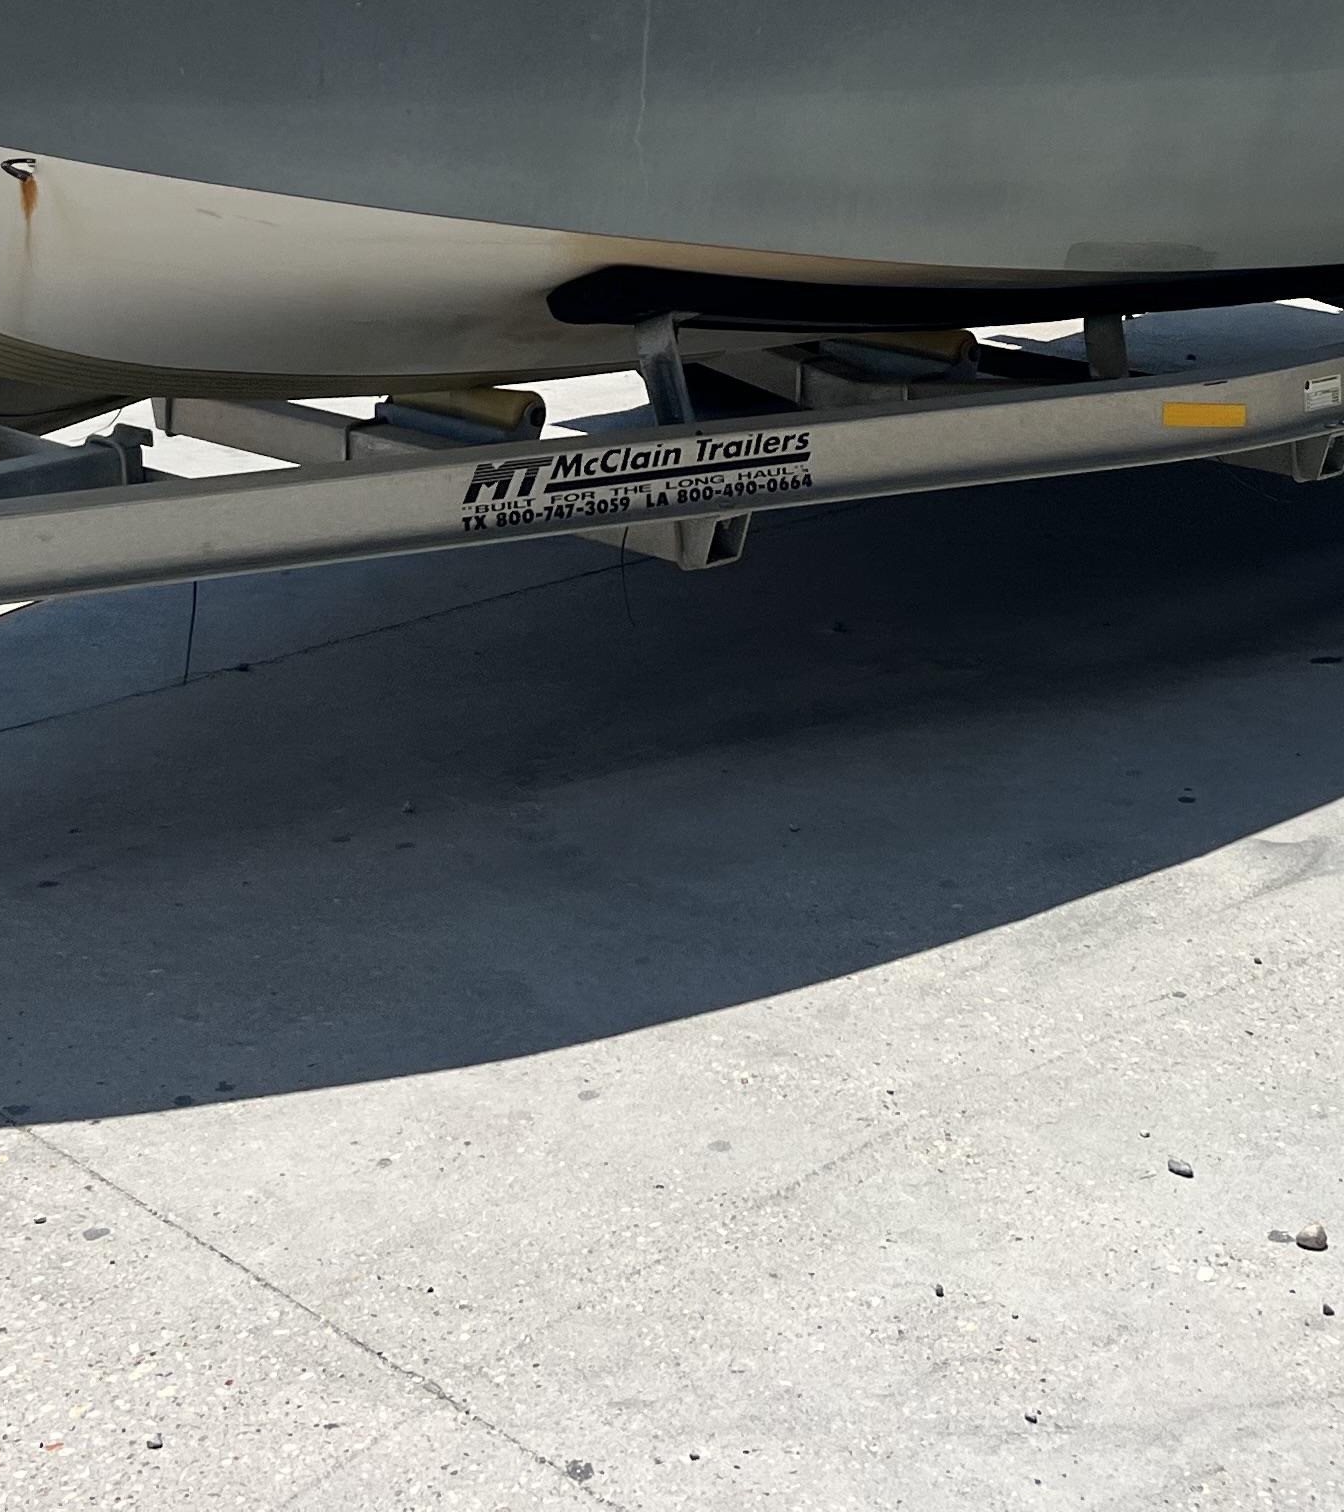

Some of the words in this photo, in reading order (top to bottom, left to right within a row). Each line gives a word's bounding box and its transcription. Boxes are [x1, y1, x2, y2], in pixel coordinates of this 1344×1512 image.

[462, 455, 555, 505] MT
[550, 442, 682, 481] McClain
[696, 431, 810, 463] Trailers
[550, 490, 596, 505] FOR
[609, 484, 652, 497] THE
[665, 474, 725, 490] LONG
[462, 514, 488, 532] TX
[496, 496, 631, 528] 800-747-3059
[646, 492, 669, 508] LA
[676, 473, 813, 504] 800-490-0664
